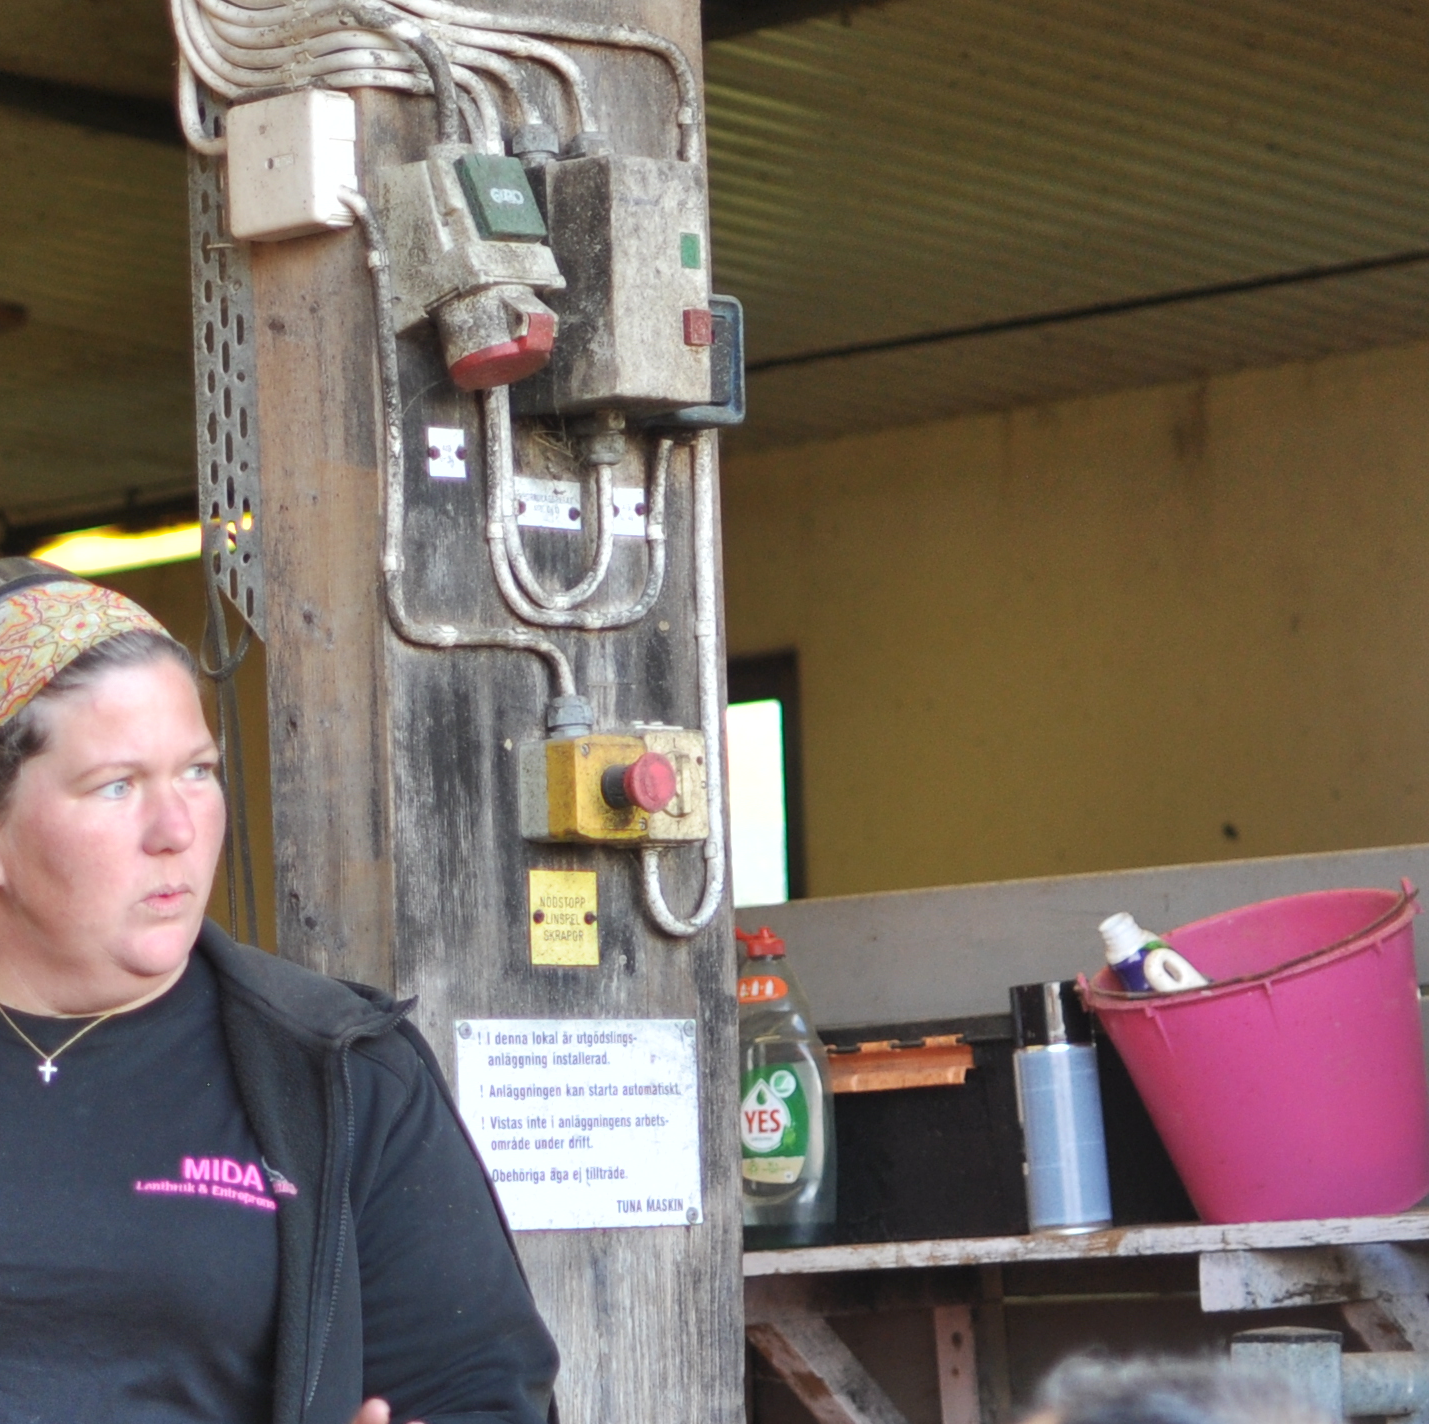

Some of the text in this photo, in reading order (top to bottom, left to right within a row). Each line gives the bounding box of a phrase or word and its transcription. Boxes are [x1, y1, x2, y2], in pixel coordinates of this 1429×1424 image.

[494, 1031, 528, 1045] denna
[532, 1031, 559, 1045] lokal
[562, 1031, 573, 1044] är
[576, 1030, 637, 1048] utgödslings-
[487, 1052, 611, 1069] anläggning installerad.
[489, 1084, 562, 1101] Anläggningen
[566, 1084, 585, 1097] kan
[588, 1083, 619, 1097] starta
[622, 1082, 682, 1096] automatiskt.
[490, 1116, 523, 1130] Vistas
[526, 1115, 547, 1129] inte
[558, 1114, 632, 1131] anläggningens
[635, 1113, 670, 1128] arbets-
[744, 1110, 781, 1133] YES
[490, 1134, 594, 1151] område under drift.
[182, 1156, 264, 1192] MIDA
[491, 1166, 629, 1184] Obehöriga äga ej tillträde.
[198, 1183, 209, 1194] &
[616, 1197, 684, 1213] TUNA MASKIN
